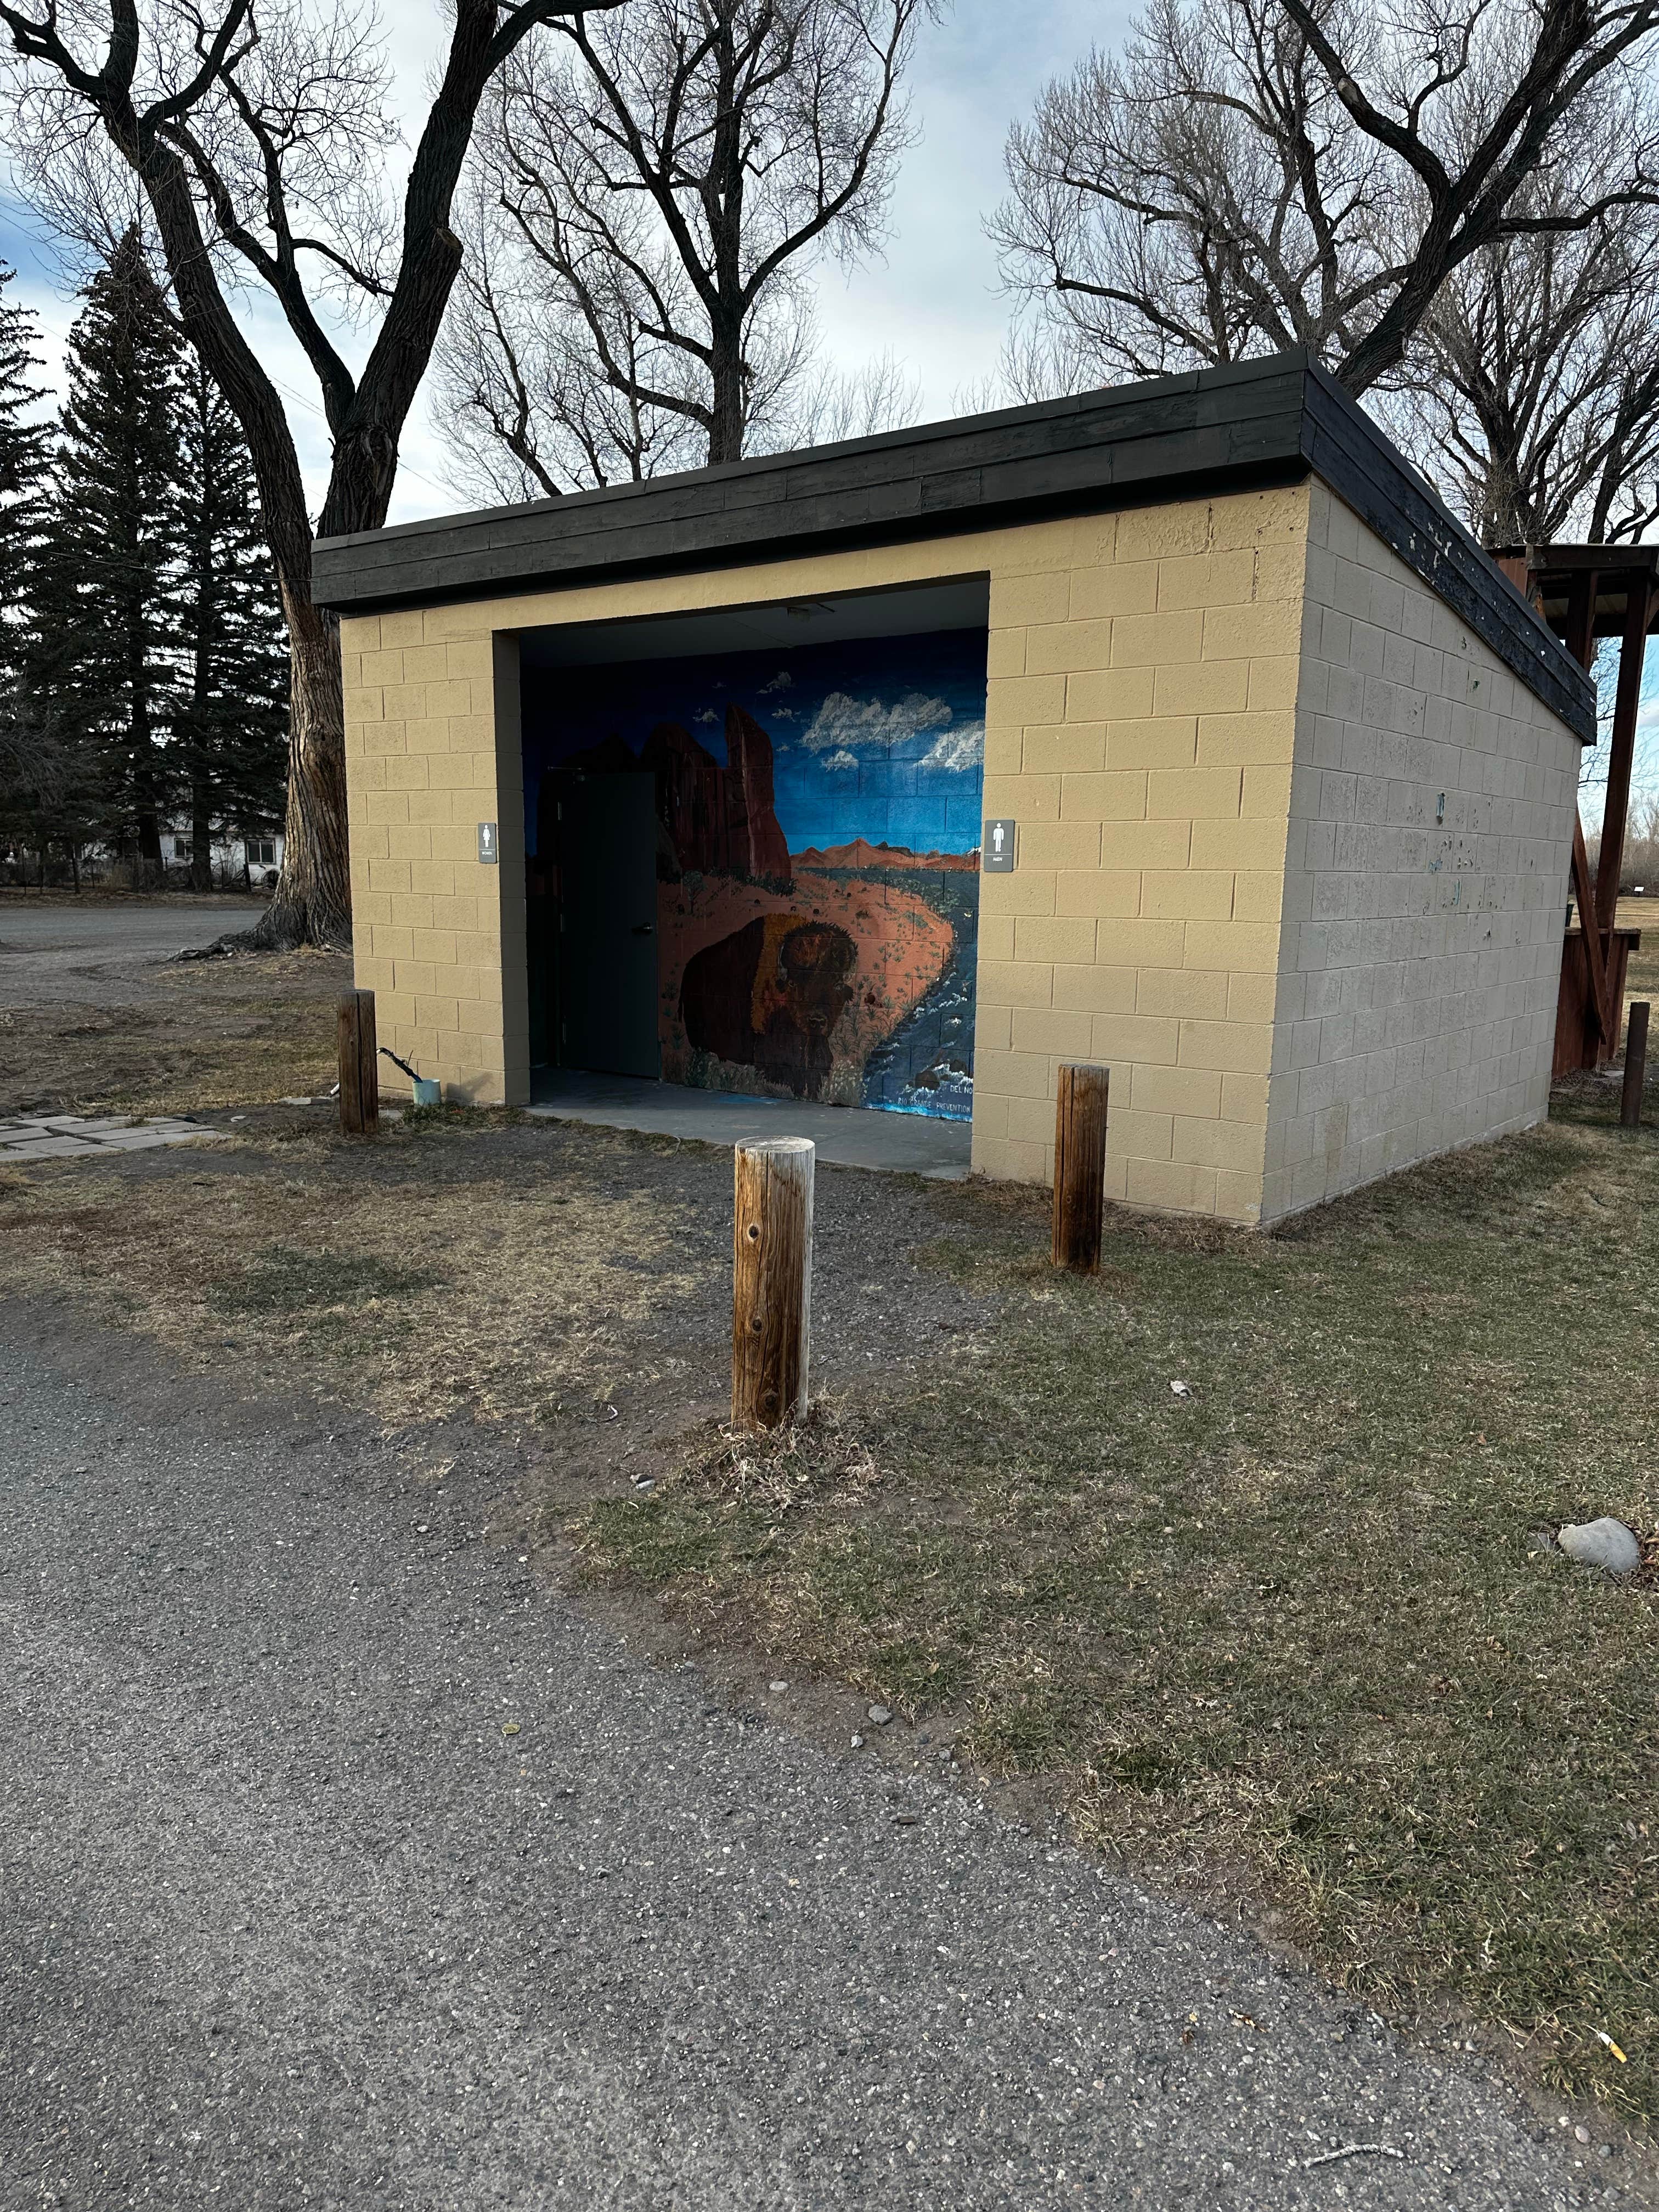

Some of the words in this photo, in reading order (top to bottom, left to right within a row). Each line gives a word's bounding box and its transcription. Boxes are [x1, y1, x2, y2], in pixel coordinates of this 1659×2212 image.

[950, 1085, 962, 1093] DEL
[909, 1098, 932, 1108] GRANDE
[936, 1102, 970, 1113] PREVENTION
